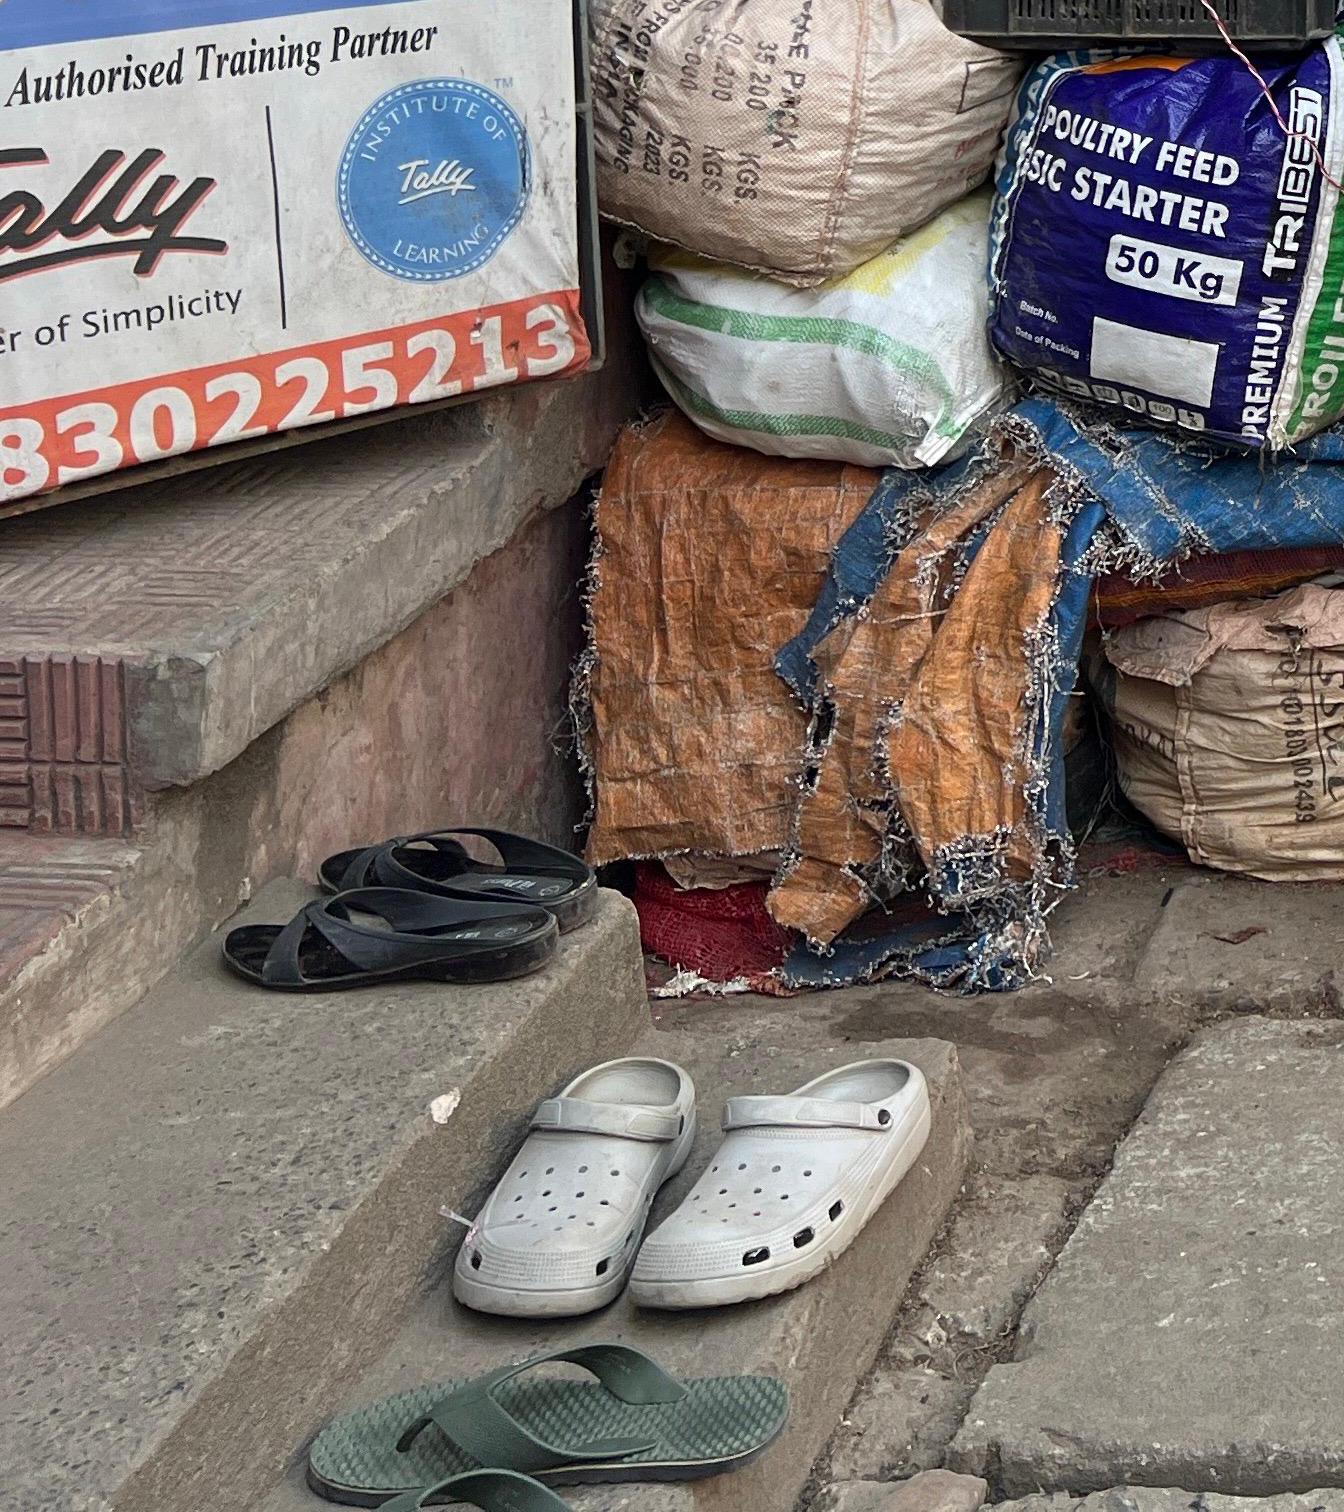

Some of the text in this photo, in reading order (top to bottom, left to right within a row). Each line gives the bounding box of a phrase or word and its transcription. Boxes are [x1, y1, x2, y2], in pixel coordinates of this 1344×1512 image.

[4, 22, 439, 108] Authorised Training Partner
[360, 95, 508, 163] INSTITUTE OF
[668, 133, 693, 186] KGS.
[1042, 104, 1153, 165] POULTRY
[1155, 140, 1241, 187] FEED
[397, 159, 477, 206] Tally
[700, 143, 726, 197] KGS.
[734, 151, 762, 205] KGS.
[1070, 167, 1231, 239] STARTER
[1113, 245, 1226, 301] 50 Kg
[1240, 86, 1324, 439] PREMIUM TRIBEST
[34, 287, 244, 348] of Simplicity
